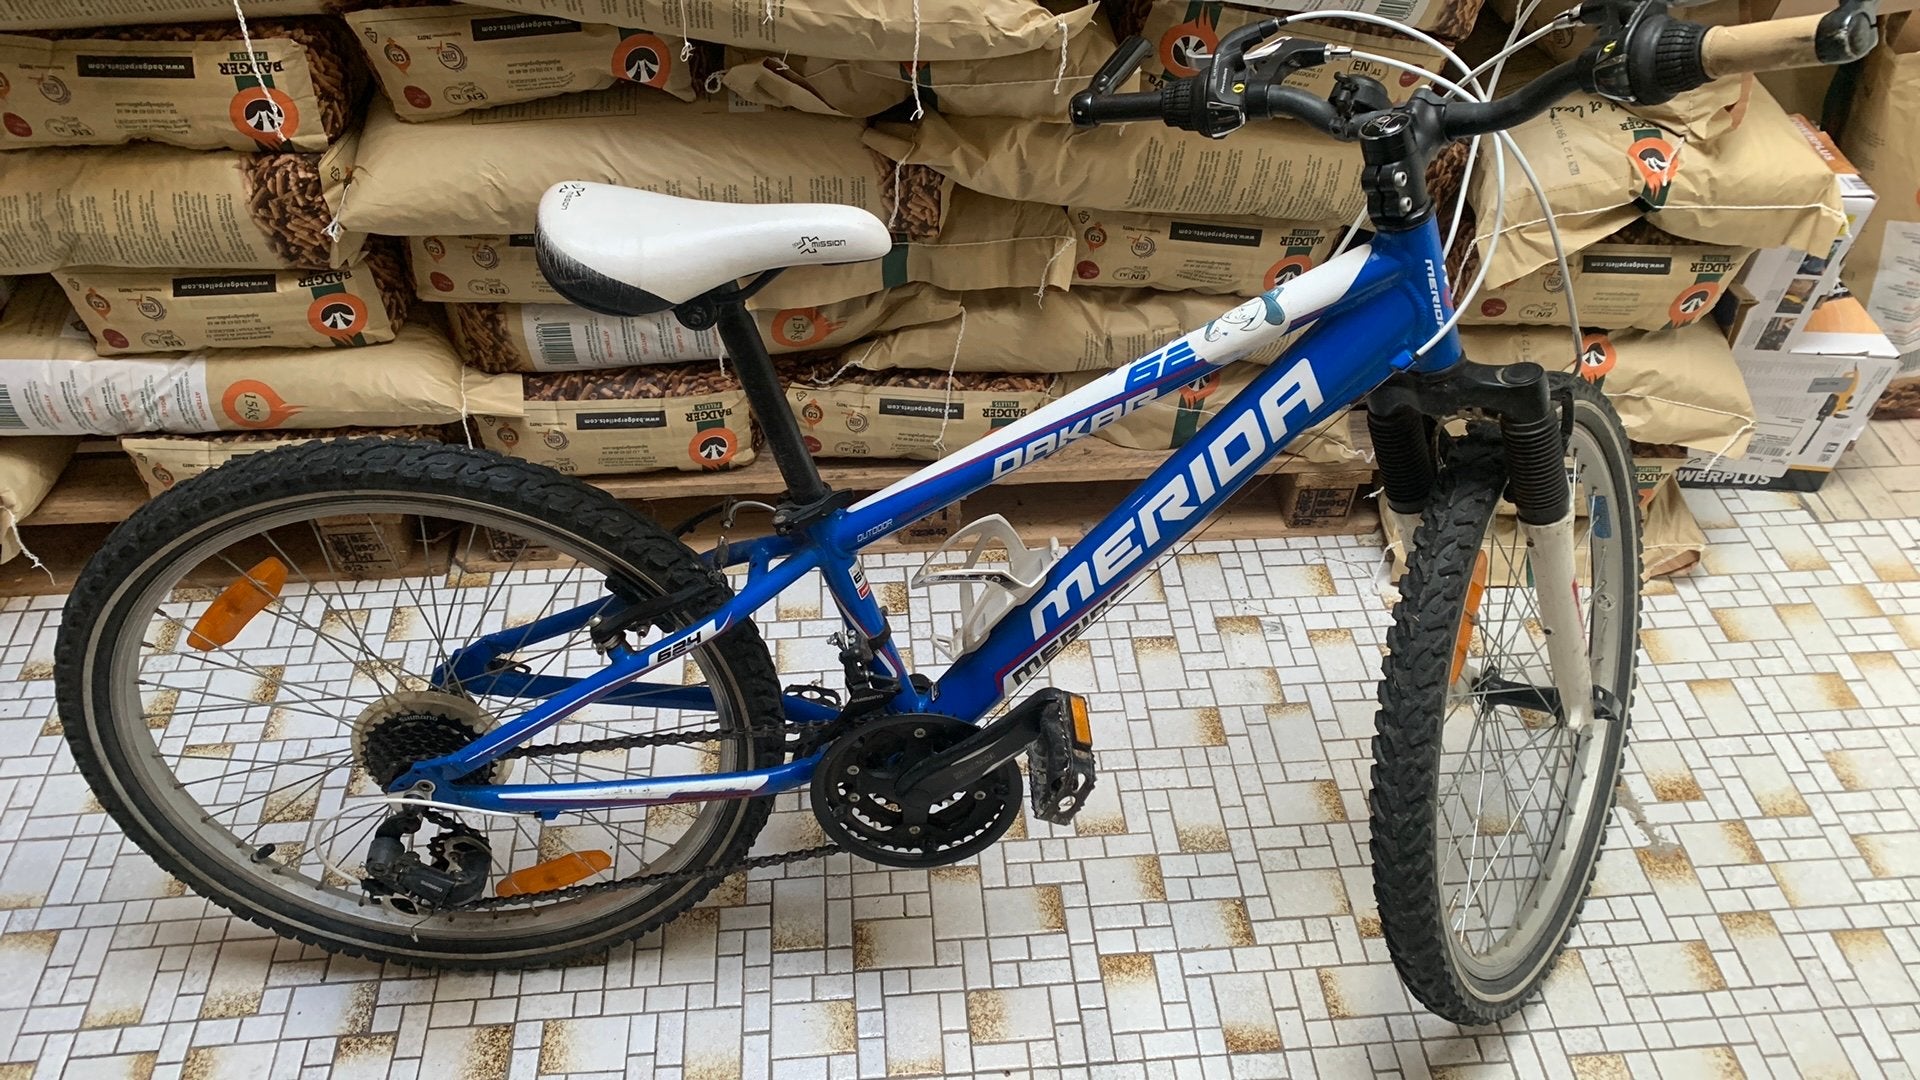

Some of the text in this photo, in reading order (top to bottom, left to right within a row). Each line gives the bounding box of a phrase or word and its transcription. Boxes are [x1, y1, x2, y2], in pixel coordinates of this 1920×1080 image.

[481, 20, 572, 32] ww.badgerpellets.com
[1352, 60, 1370, 72] EN
[685, 409, 733, 421] BADGER
[982, 407, 1029, 419] BADGER
[584, 415, 661, 425] www.badgerpellets.com
[1674, 469, 1771, 486] WERPLUS
[1030, 357, 1324, 642] MERIDA
[857, 518, 894, 543] OUTDOOR
[656, 633, 703, 663] 624
